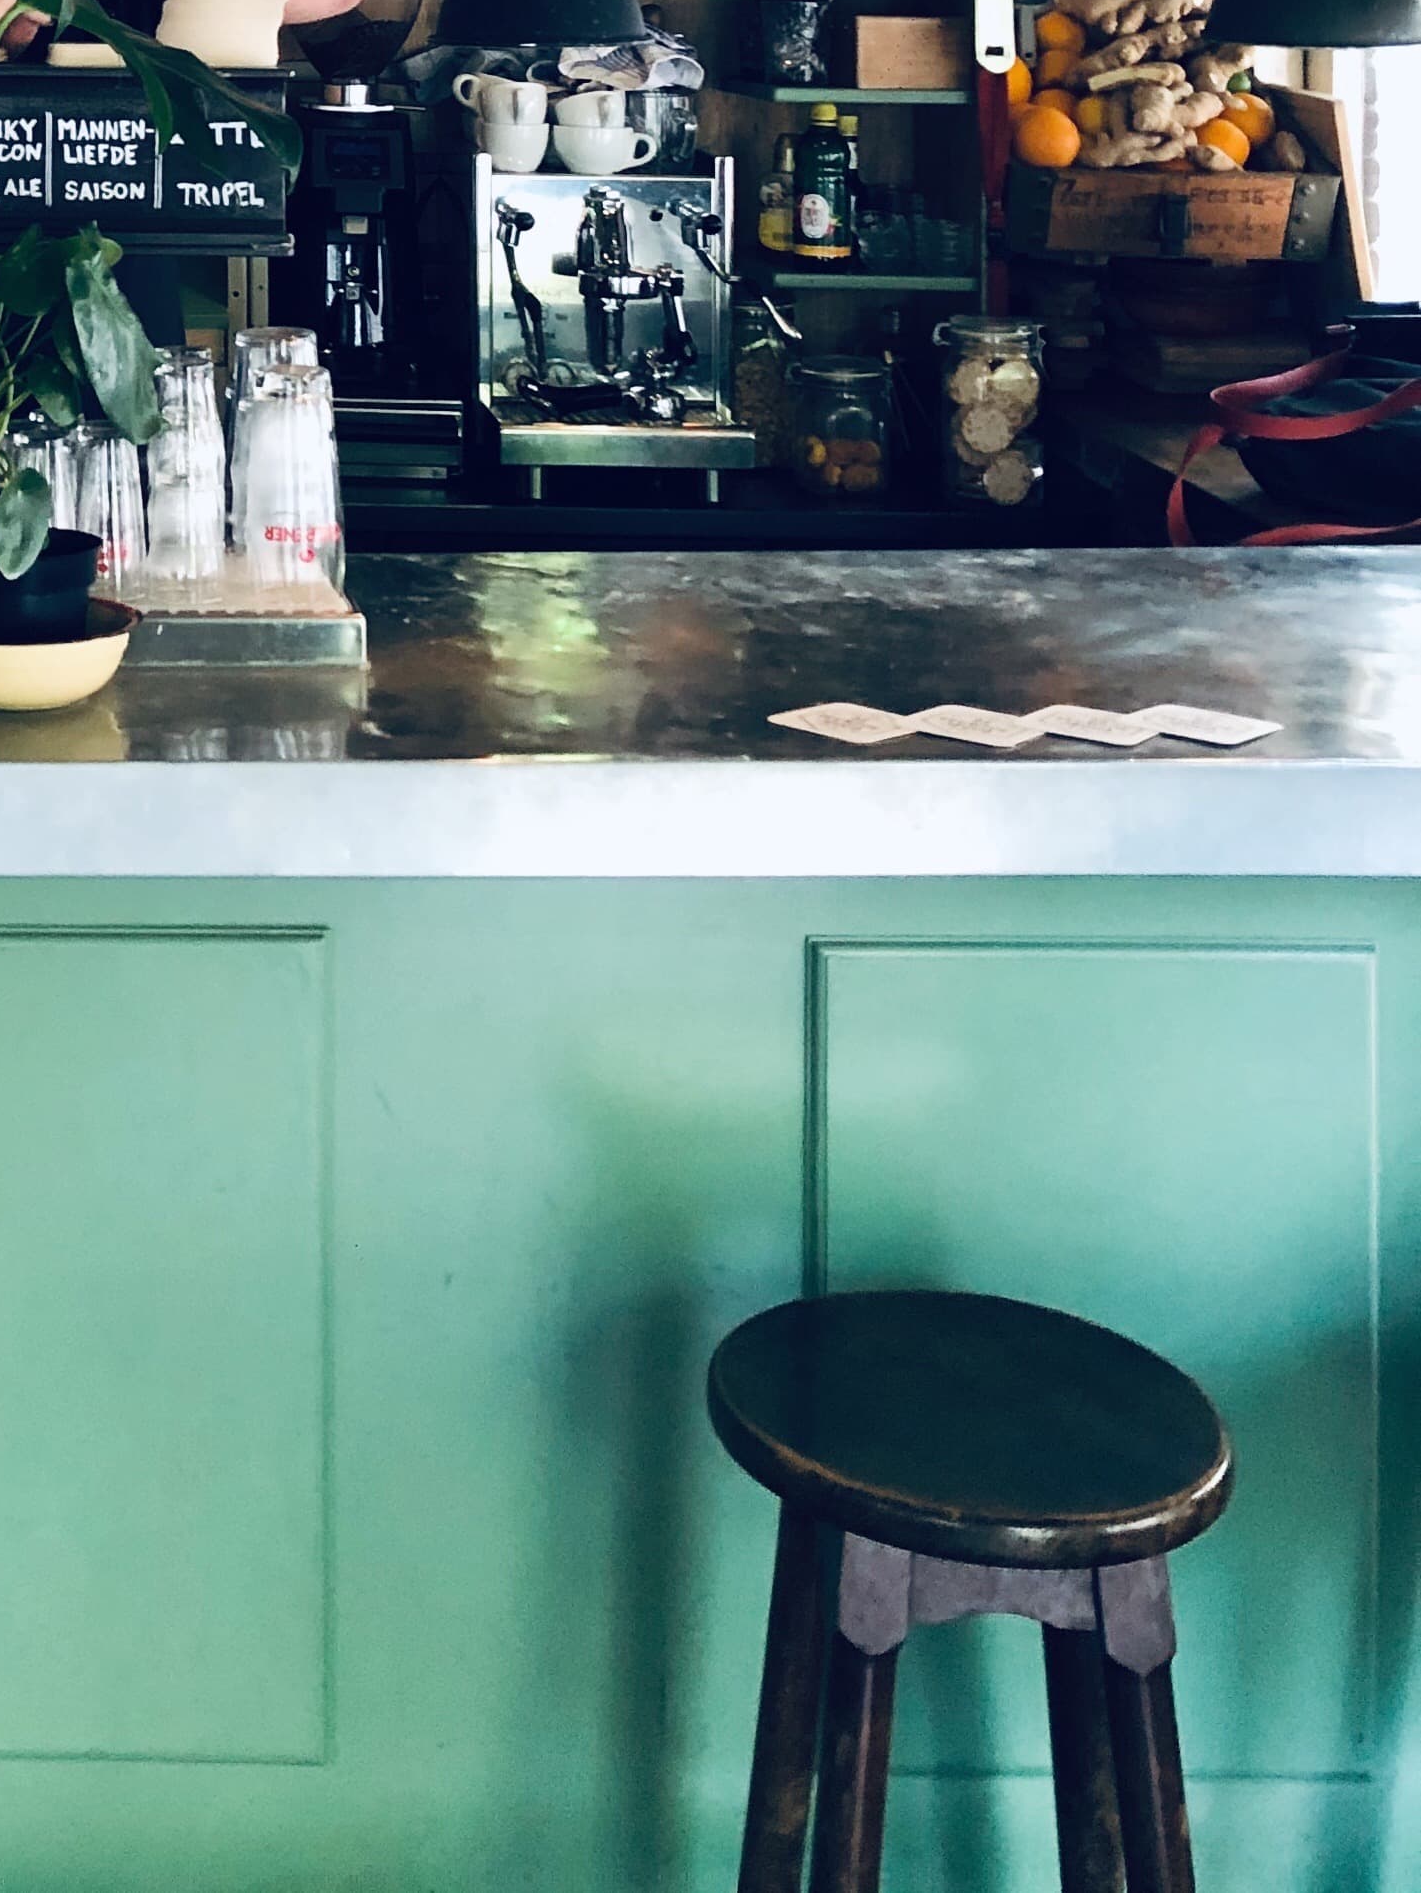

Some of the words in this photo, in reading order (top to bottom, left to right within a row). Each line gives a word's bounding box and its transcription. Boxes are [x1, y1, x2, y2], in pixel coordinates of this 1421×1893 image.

[58, 118, 155, 142] MANNEN-
[63, 143, 137, 166] LIEFDE
[3, 177, 43, 198] ALE
[64, 180, 146, 202] SAISON
[176, 181, 265, 207] TRIPEL
